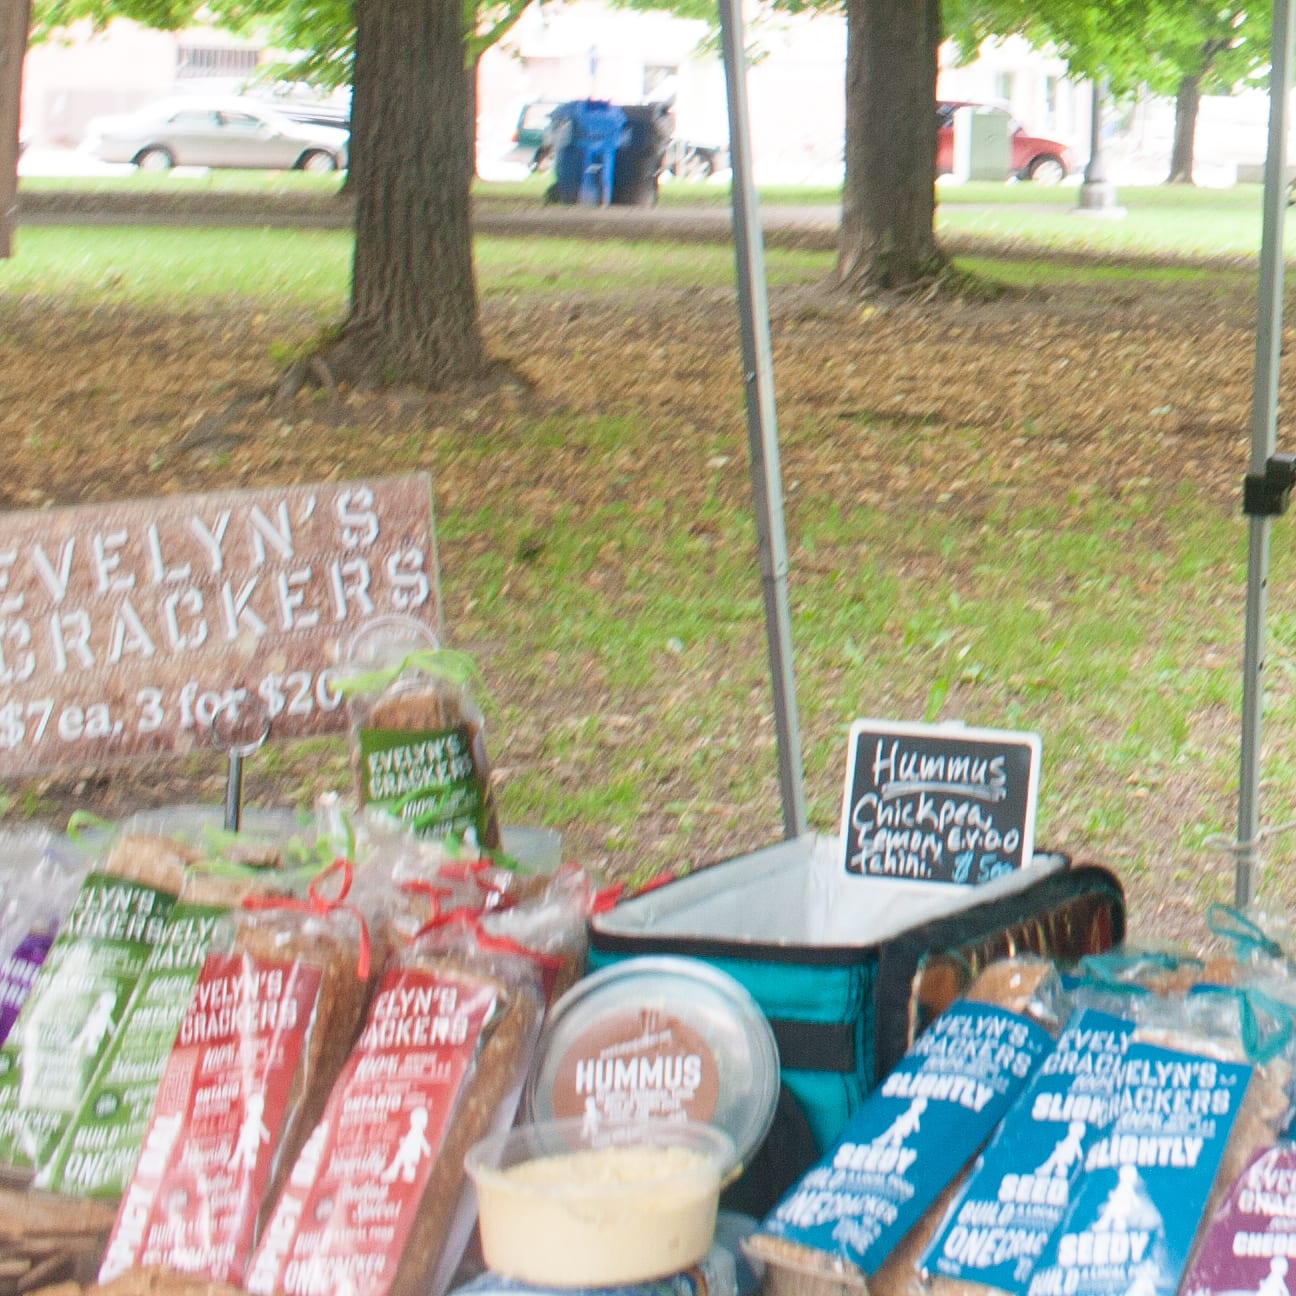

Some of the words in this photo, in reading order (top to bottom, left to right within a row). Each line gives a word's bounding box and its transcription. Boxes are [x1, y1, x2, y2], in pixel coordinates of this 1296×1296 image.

[0, 546, 430, 685] CRACKERS
[135, 685, 164, 733] 3
[178, 678, 247, 728] for
[575, 1053, 701, 1095] HUMMUS
[998, 1173, 1069, 1206] SEED
